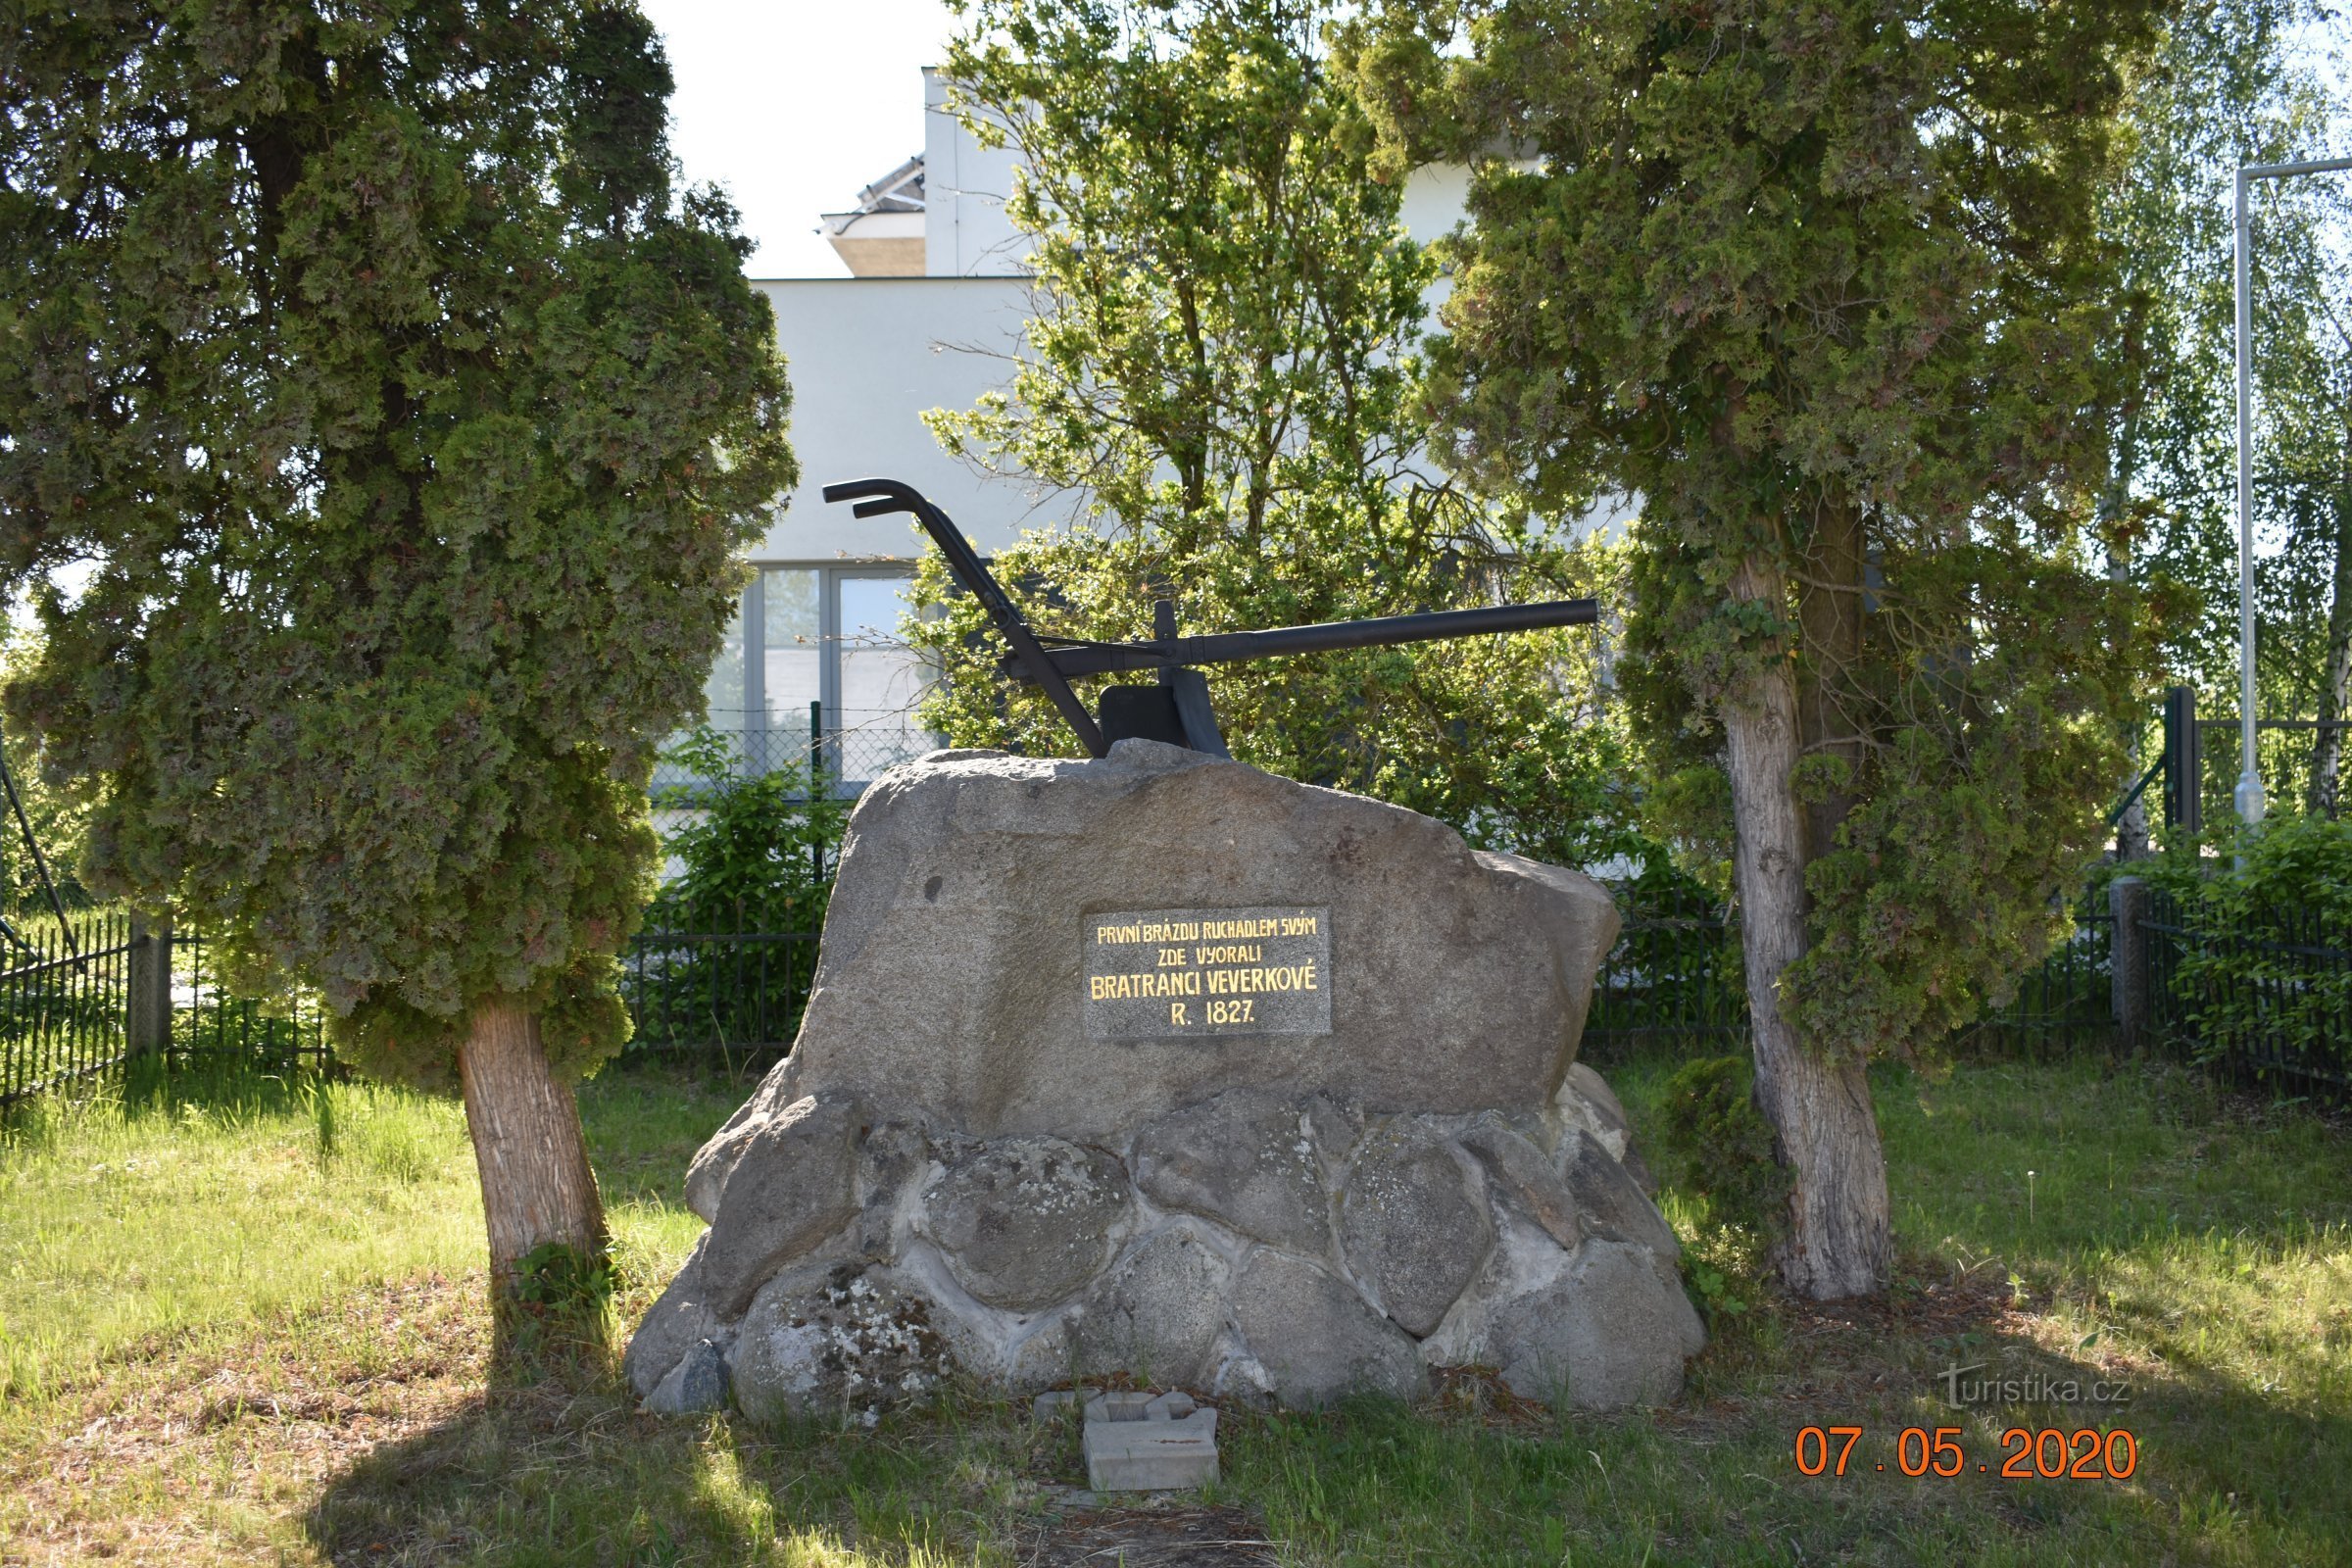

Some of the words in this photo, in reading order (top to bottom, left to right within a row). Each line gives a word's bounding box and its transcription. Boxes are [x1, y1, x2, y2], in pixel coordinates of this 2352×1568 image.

[1097, 919, 1141, 945] PRVNÍ
[1143, 917, 1200, 942] BRÁZDU
[1202, 918, 1279, 939] RUCHADLEM
[1281, 909, 1317, 936] SVÝM
[1156, 949, 1187, 967] ZDE
[1196, 945, 1261, 965] VYORALI
[1090, 970, 1200, 1001] BRATRANCI
[1206, 957, 1318, 994] VEVERKOVÉ
[1171, 1002, 1193, 1026] R.
[1206, 999, 1255, 1025] 1827.
